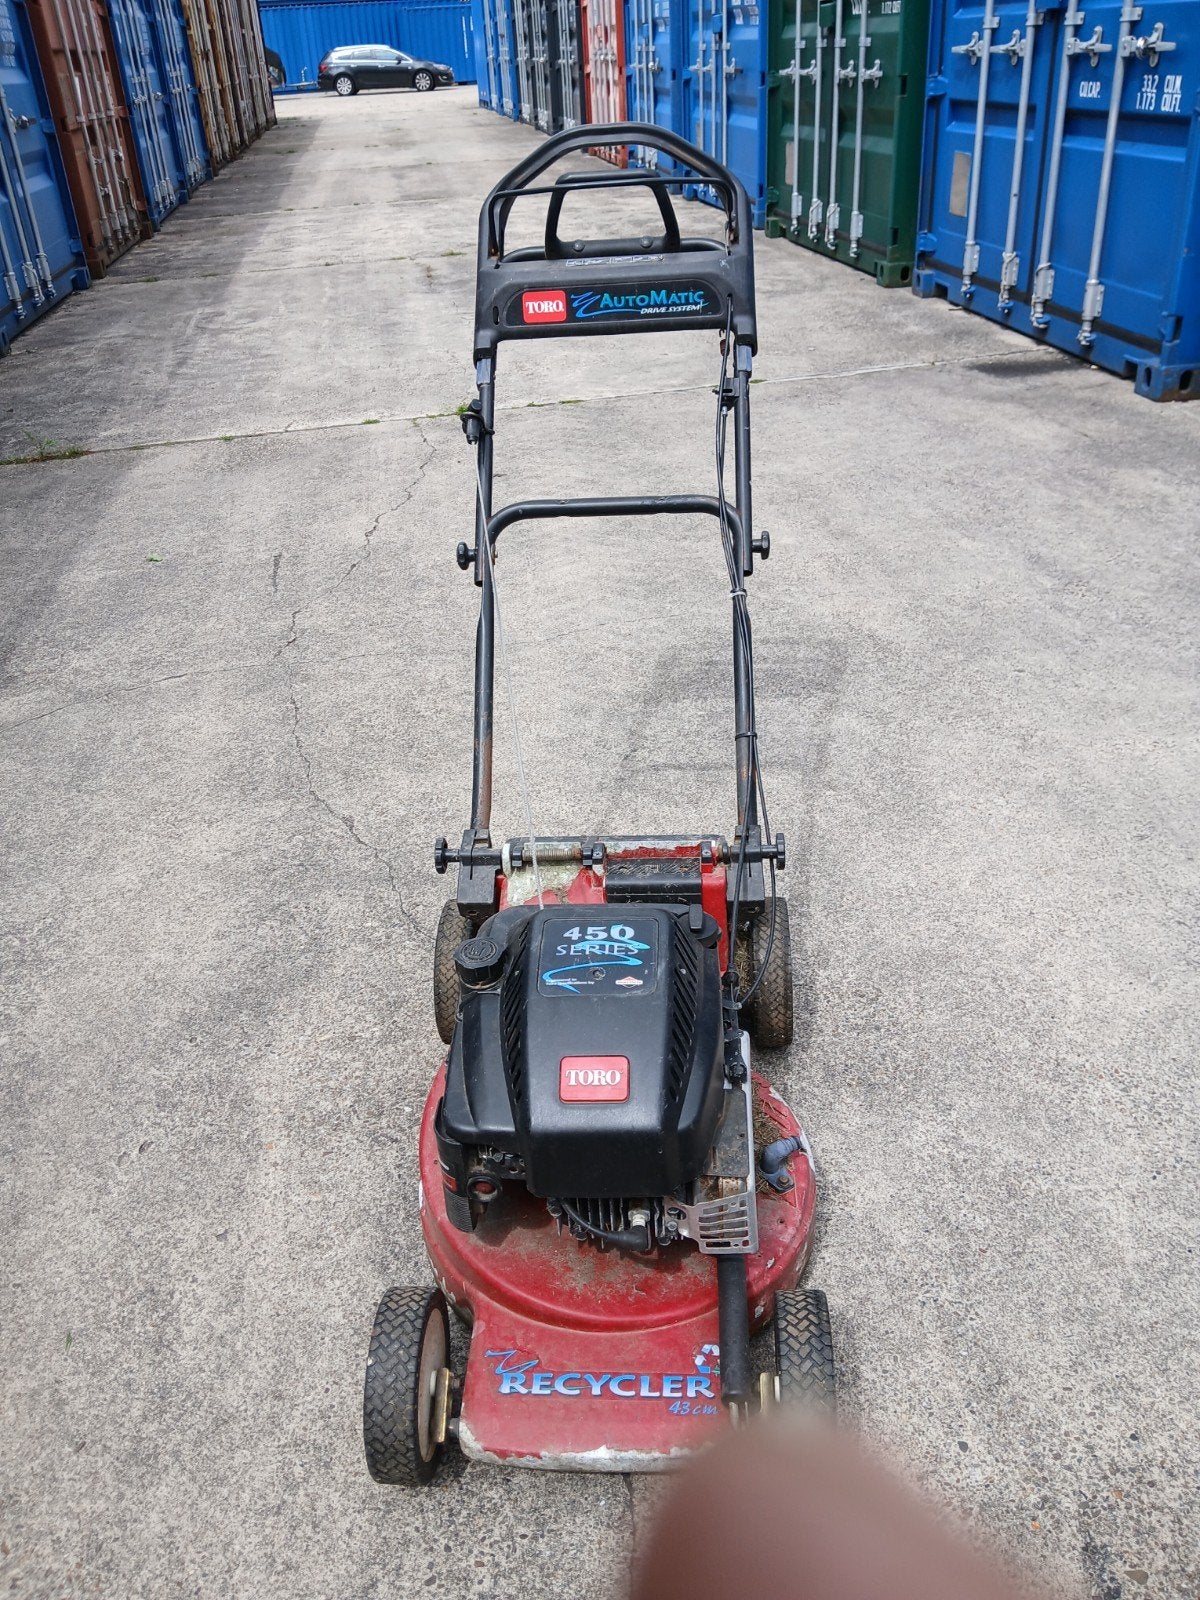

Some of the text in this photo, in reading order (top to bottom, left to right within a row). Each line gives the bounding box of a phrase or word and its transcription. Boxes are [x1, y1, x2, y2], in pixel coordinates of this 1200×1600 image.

[1142, 75, 1159, 93] 33.2
[1136, 92, 1156, 111] 1.173
[526, 301, 564, 314] TORO
[641, 305, 700, 314] DRIVE SYSTEM
[563, 926, 635, 941] 450
[556, 944, 639, 955] SERIES
[566, 1069, 621, 1086] TORO
[498, 1373, 715, 1398] RECYCLER
[669, 1401, 719, 1415] 43 cm
